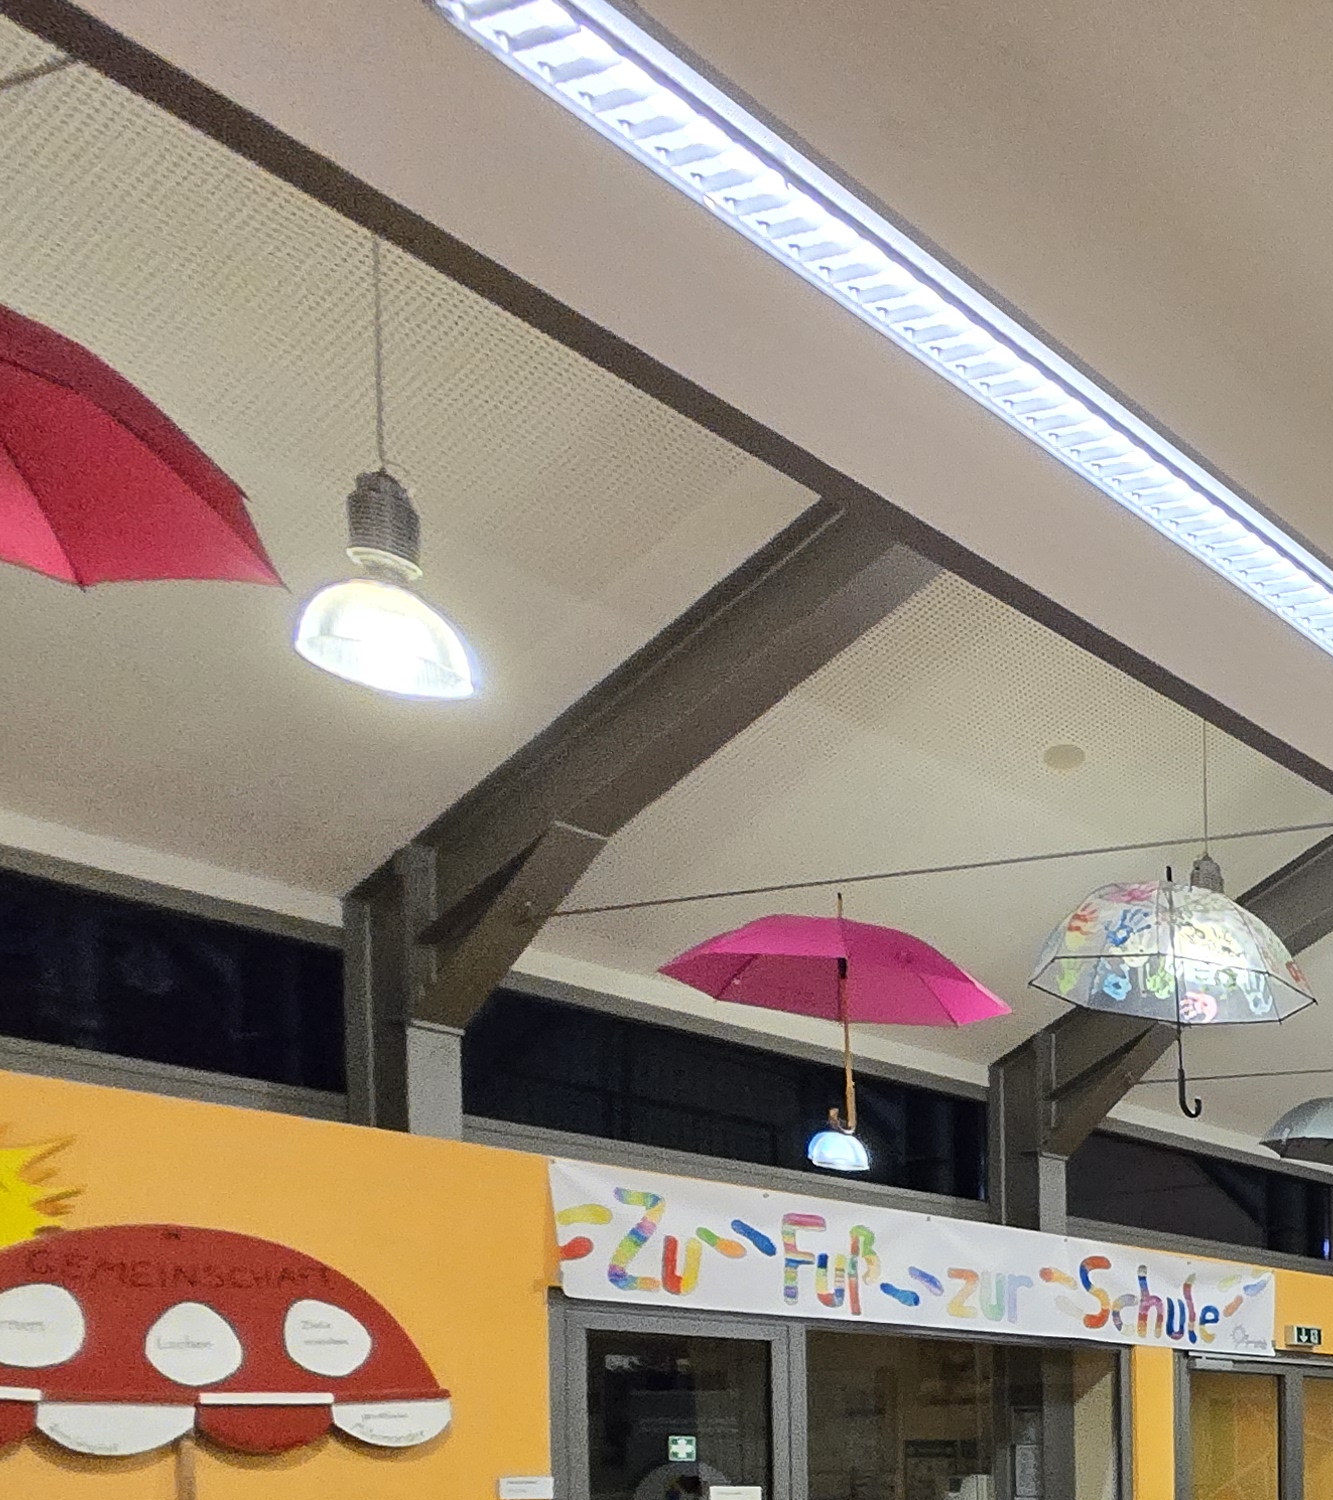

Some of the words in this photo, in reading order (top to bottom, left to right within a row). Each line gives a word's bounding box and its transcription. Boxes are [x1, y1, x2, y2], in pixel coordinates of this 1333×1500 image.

[607, 1187, 703, 1296] Zu
[781, 1213, 881, 1316] Fuß
[947, 1267, 1034, 1324] zur
[1079, 1256, 1221, 1344] Schule
